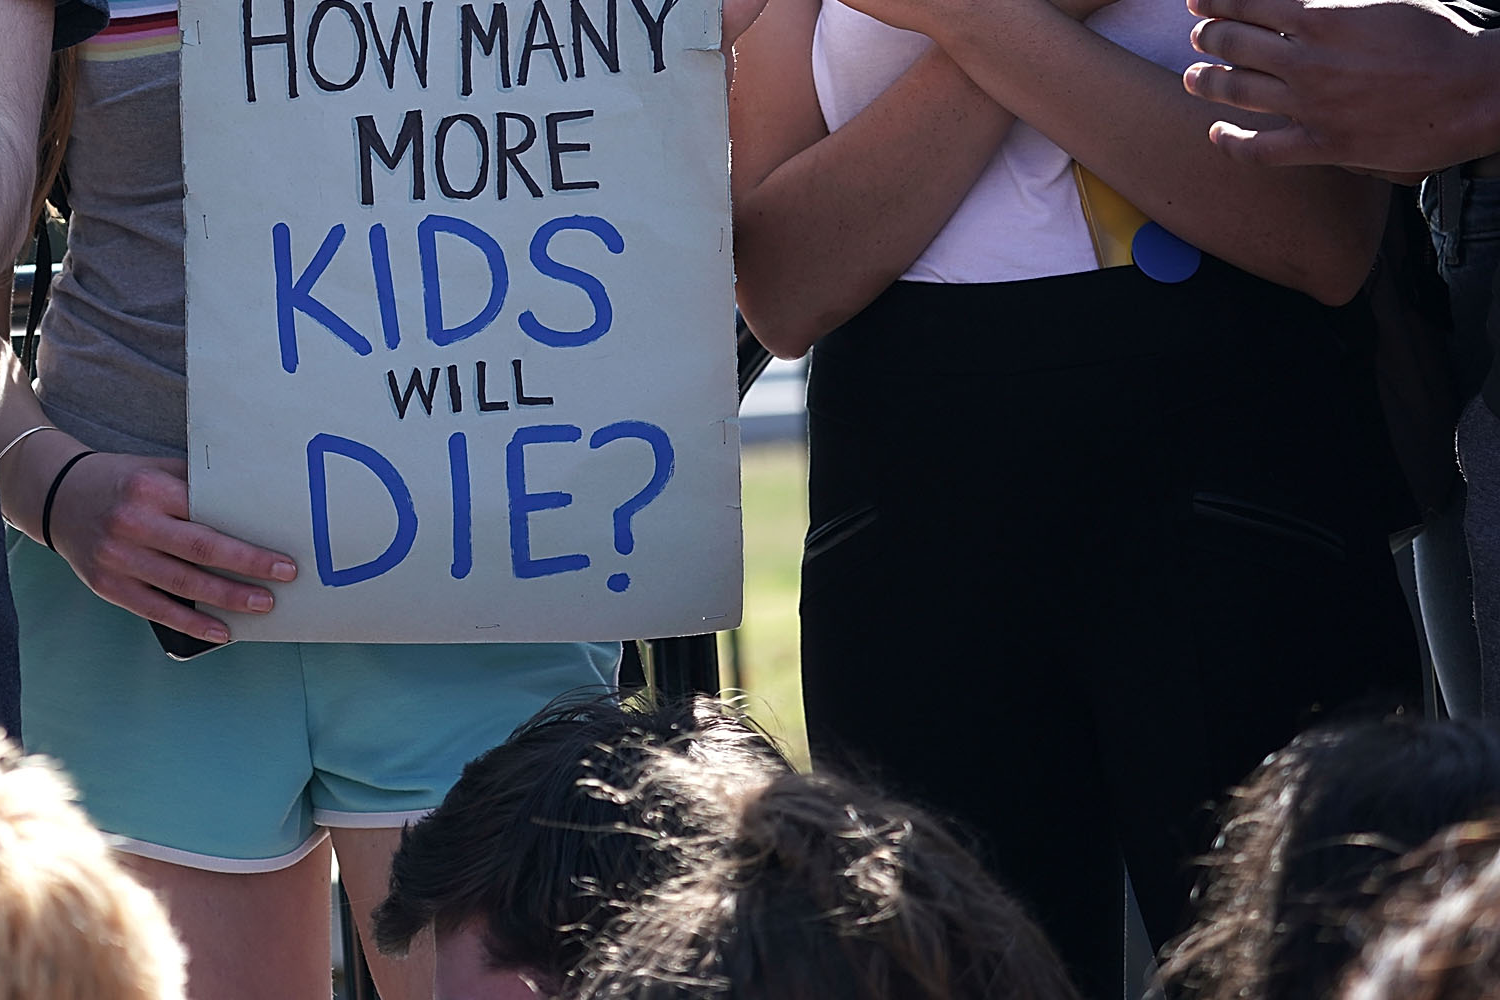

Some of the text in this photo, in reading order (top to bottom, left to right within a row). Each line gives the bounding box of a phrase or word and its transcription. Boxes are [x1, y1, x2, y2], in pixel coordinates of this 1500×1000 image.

[353, 109, 600, 206] MORE
[271, 213, 625, 374] KIDS
[386, 358, 554, 420] WILL
[306, 419, 676, 594] DIE?
